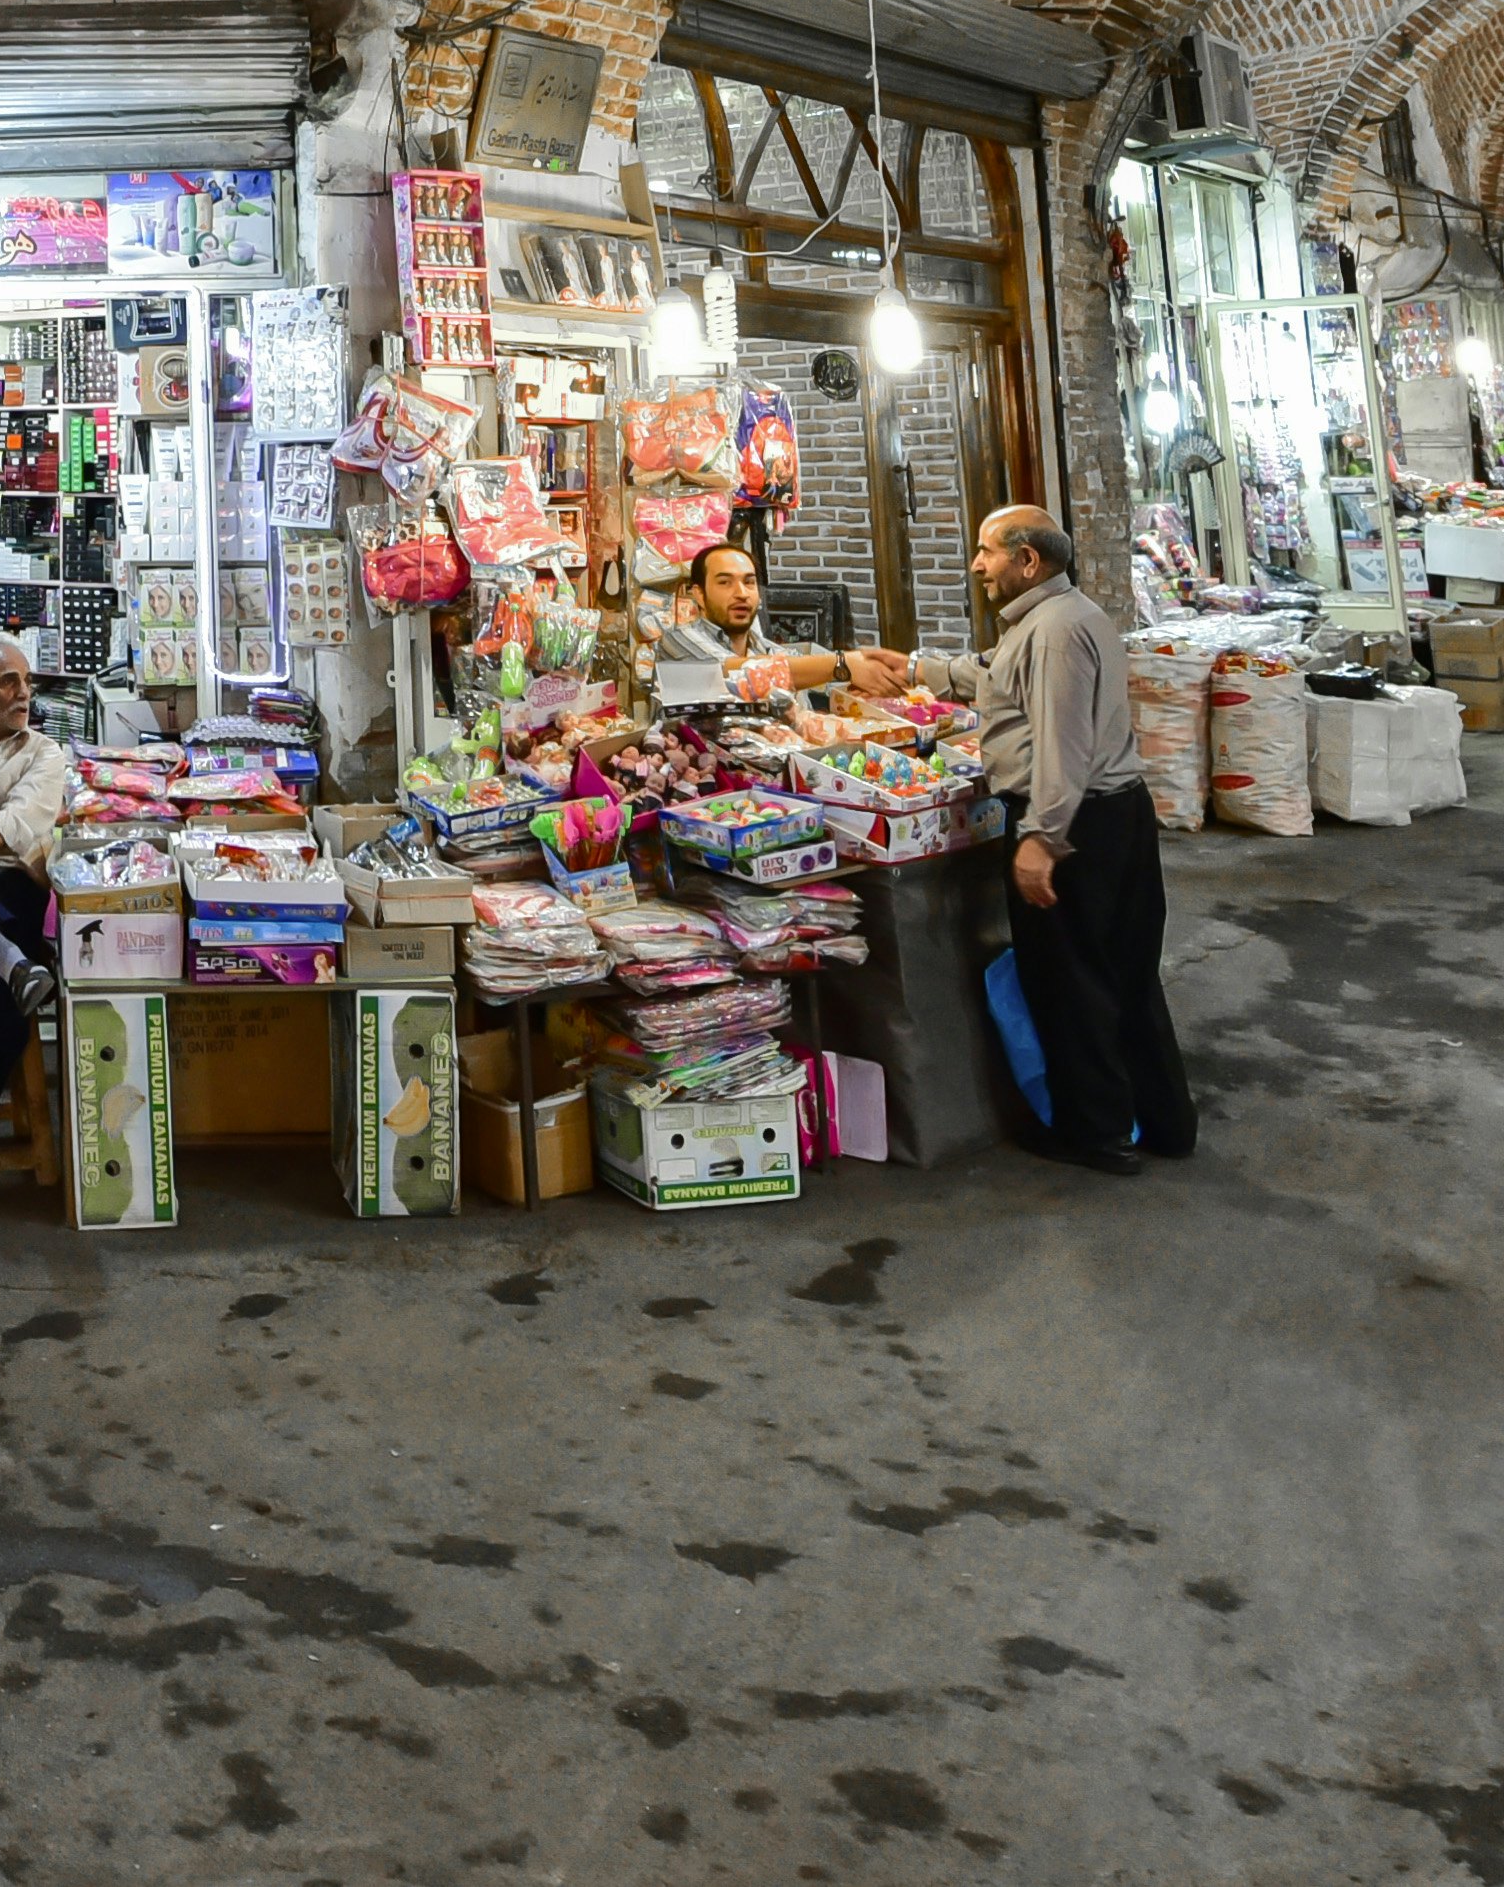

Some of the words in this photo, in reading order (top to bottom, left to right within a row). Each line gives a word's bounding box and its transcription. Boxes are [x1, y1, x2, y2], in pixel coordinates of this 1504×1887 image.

[519, 133, 547, 154] Rasta
[116, 931, 166, 949] PANTENE
[148, 1013, 165, 1105] PREMIUM
[363, 1012, 377, 1105] BANANAS
[76, 1036, 101, 1188] BANANEC
[430, 1032, 452, 1183] BANANEC
[152, 1110, 170, 1206] BANANAS
[363, 1108, 377, 1199] PREMIUM
[663, 1184, 727, 1200] BANANAS
[728, 1179, 789, 1196] PREMIUM
